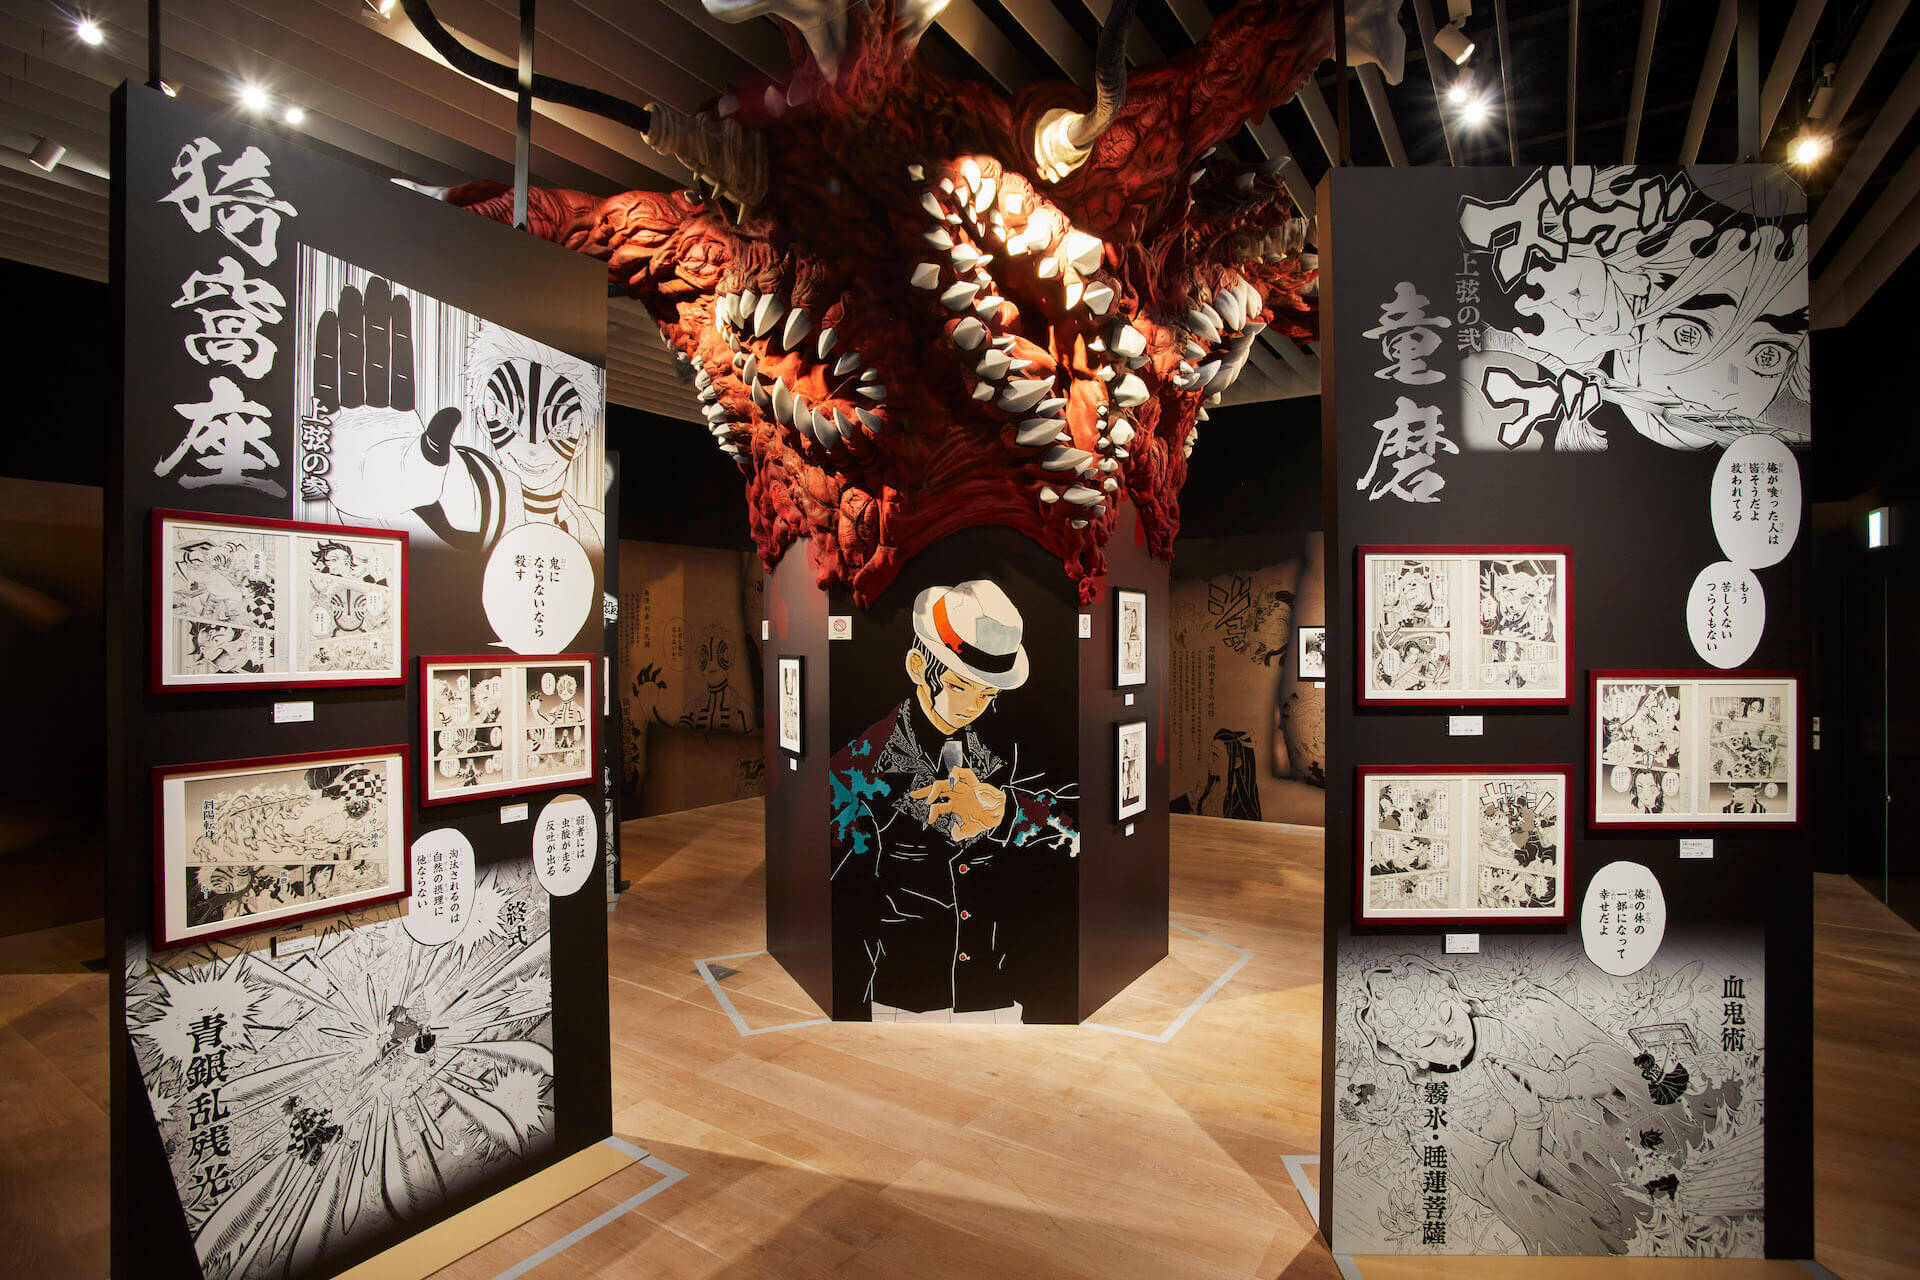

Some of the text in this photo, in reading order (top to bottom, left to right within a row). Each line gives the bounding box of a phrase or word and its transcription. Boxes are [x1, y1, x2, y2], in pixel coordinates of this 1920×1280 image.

[154, 137, 298, 498] 猗窩座
[1357, 281, 1459, 503] 童磨
[1731, 462, 1743, 522] 救われてる
[1749, 462, 1761, 522] 皆そうだよ
[1767, 462, 1780, 545] 俺が喰った人は
[515, 554, 526, 581] 殺す
[534, 556, 545, 638] ならないなら
[550, 556, 560, 583] 鬼に
[1740, 581, 1749, 605] もう
[1706, 582, 1718, 652] つらくもない
[1721, 581, 1733, 640] 苦しくない
[545, 819, 557, 878] 反吐が出る
[561, 817, 572, 874] 虫酸が走る
[576, 815, 585, 859] 弱者には
[416, 855, 428, 909] 他ならない
[433, 851, 444, 917] 自然の摂理に
[449, 848, 461, 923] 淘汰されるのは
[1599, 888, 1610, 936] 幸せだよ
[1634, 888, 1646, 935] 俺の体の
[506, 900, 529, 950] 終式
[1616, 891, 1628, 960] 一部になって
[1720, 975, 1746, 1052] 血鬼術
[186, 1013, 231, 1209] 青銀乱残光
[1423, 1081, 1449, 1245] 霧氷・睡蓮菩薩
